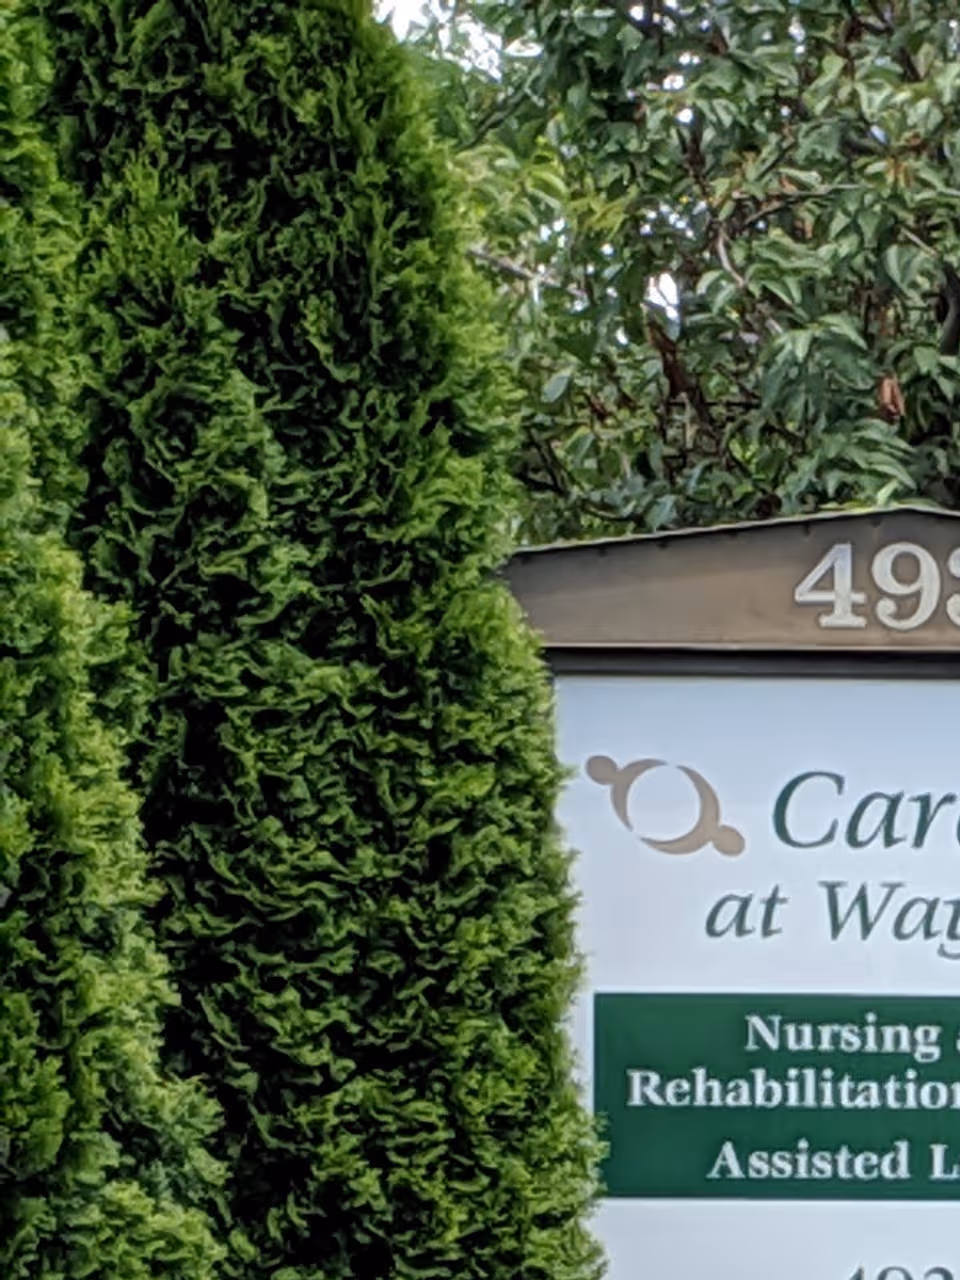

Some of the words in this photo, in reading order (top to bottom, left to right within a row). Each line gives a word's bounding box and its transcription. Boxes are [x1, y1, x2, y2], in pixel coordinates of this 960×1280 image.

[705, 884, 789, 940] at
[745, 1014, 941, 1063] Nursing
[707, 1141, 910, 1180] Assisted
